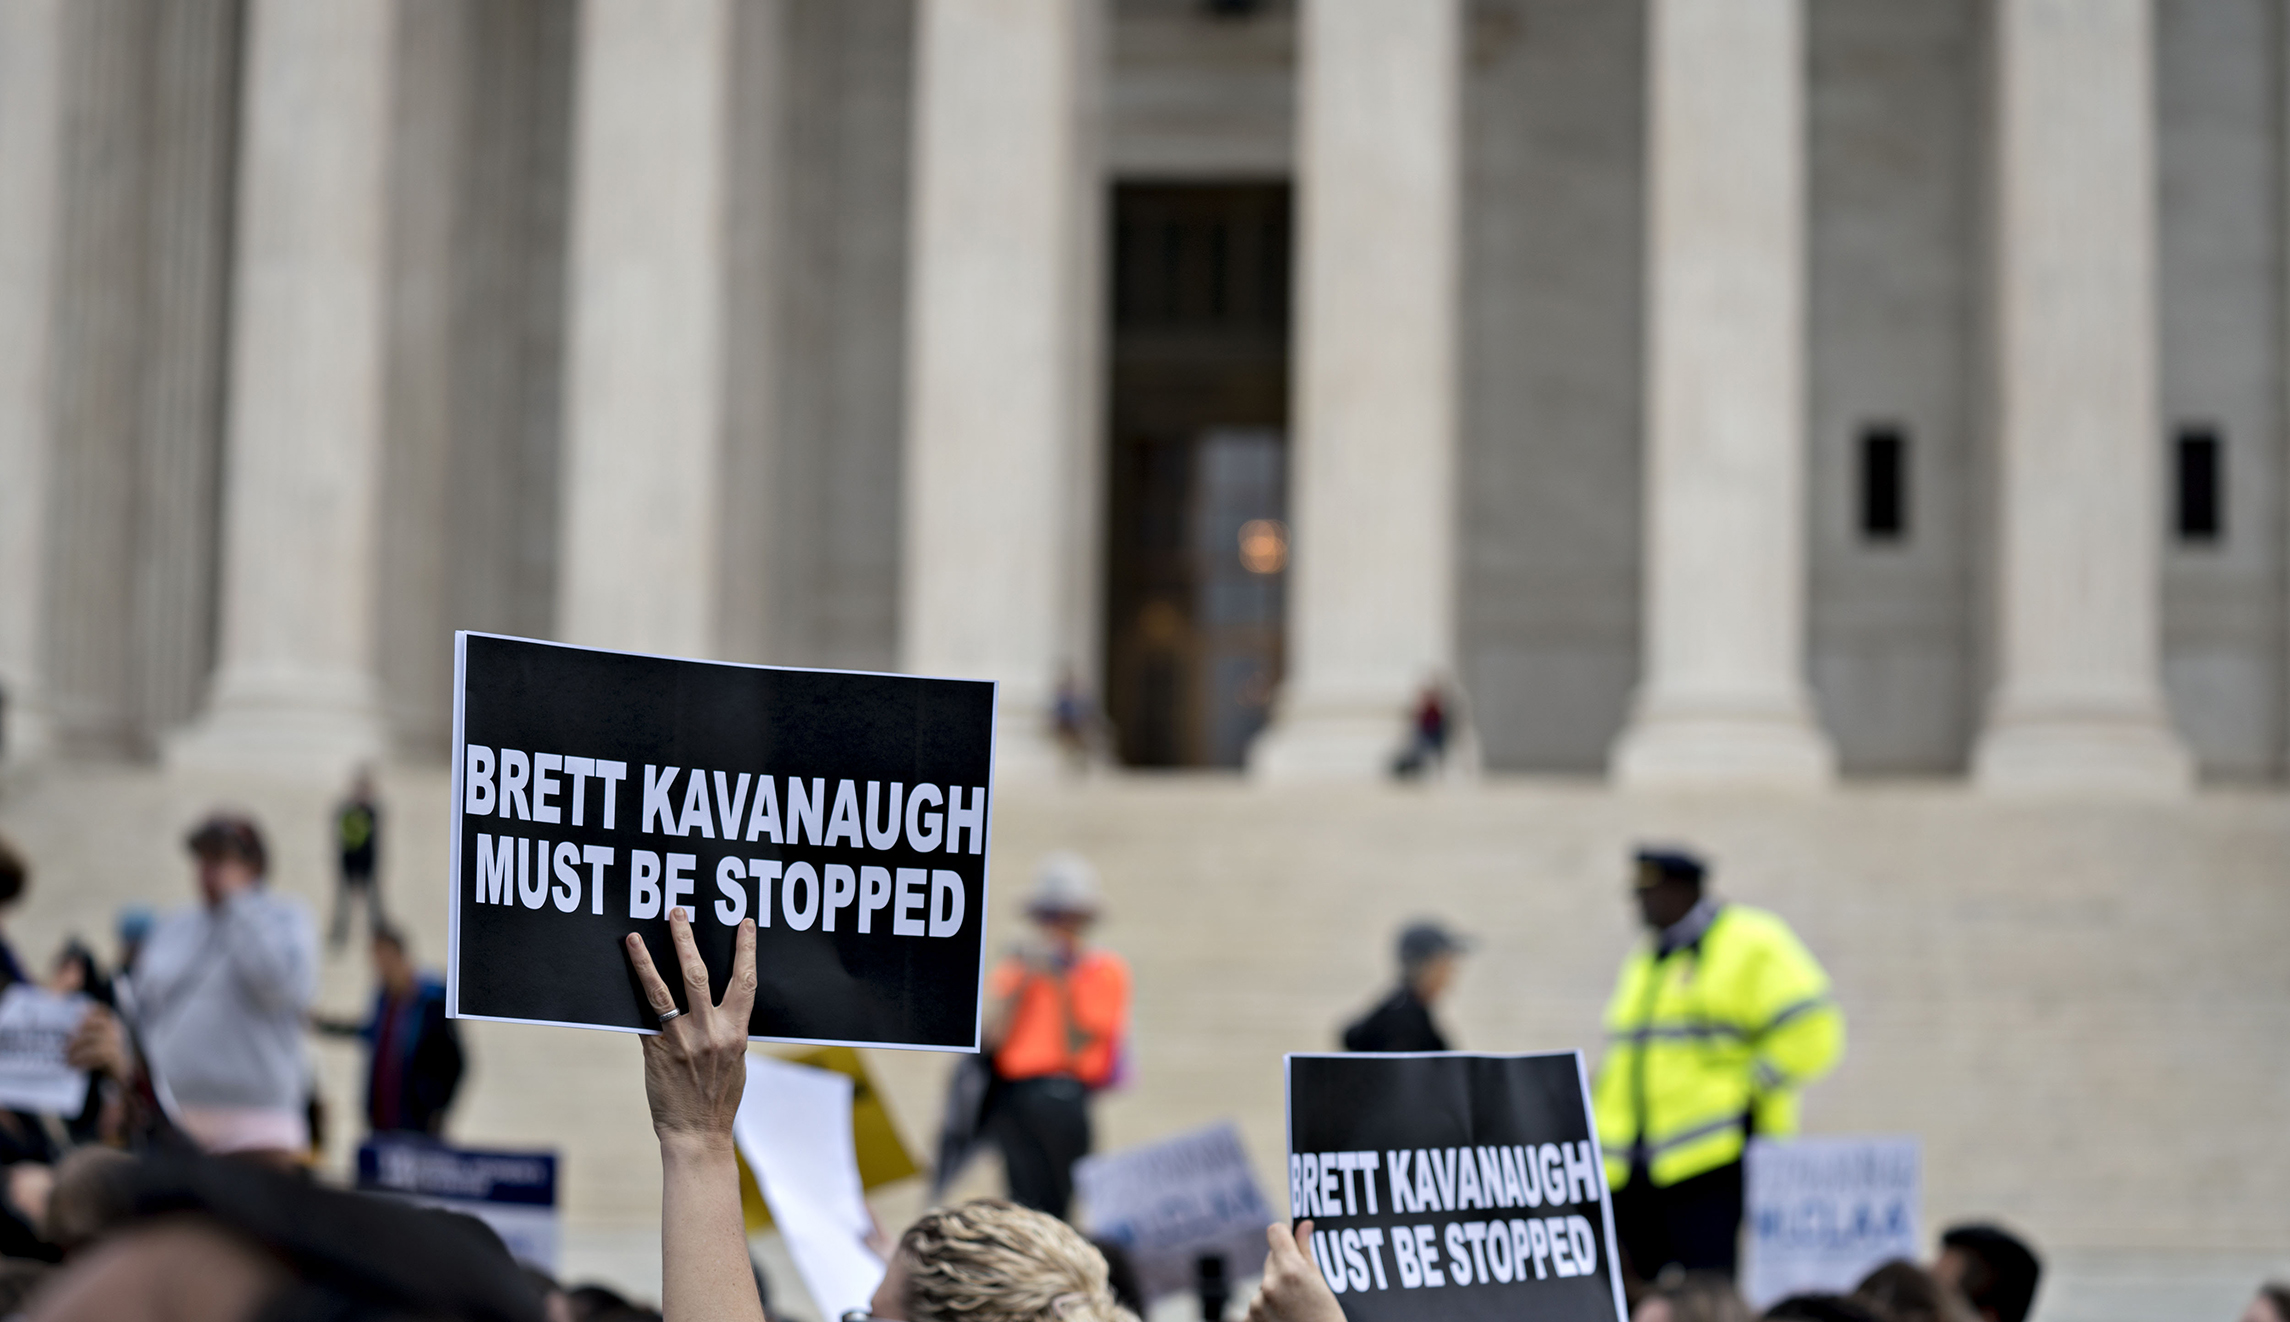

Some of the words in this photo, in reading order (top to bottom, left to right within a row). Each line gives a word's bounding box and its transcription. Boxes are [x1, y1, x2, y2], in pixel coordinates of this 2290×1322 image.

[466, 744, 627, 829] BRETT
[642, 764, 986, 855] KAVANAUGH
[475, 833, 614, 915] MUST
[630, 849, 696, 923] BE
[714, 856, 965, 938] STOPPED
[1292, 1151, 1380, 1218] BRETT
[1386, 1140, 1600, 1213] KAVANAUGH
[1309, 1227, 1388, 1293] UST
[1390, 1225, 1446, 1288] BE
[1445, 1215, 1597, 1286] STOPPED
